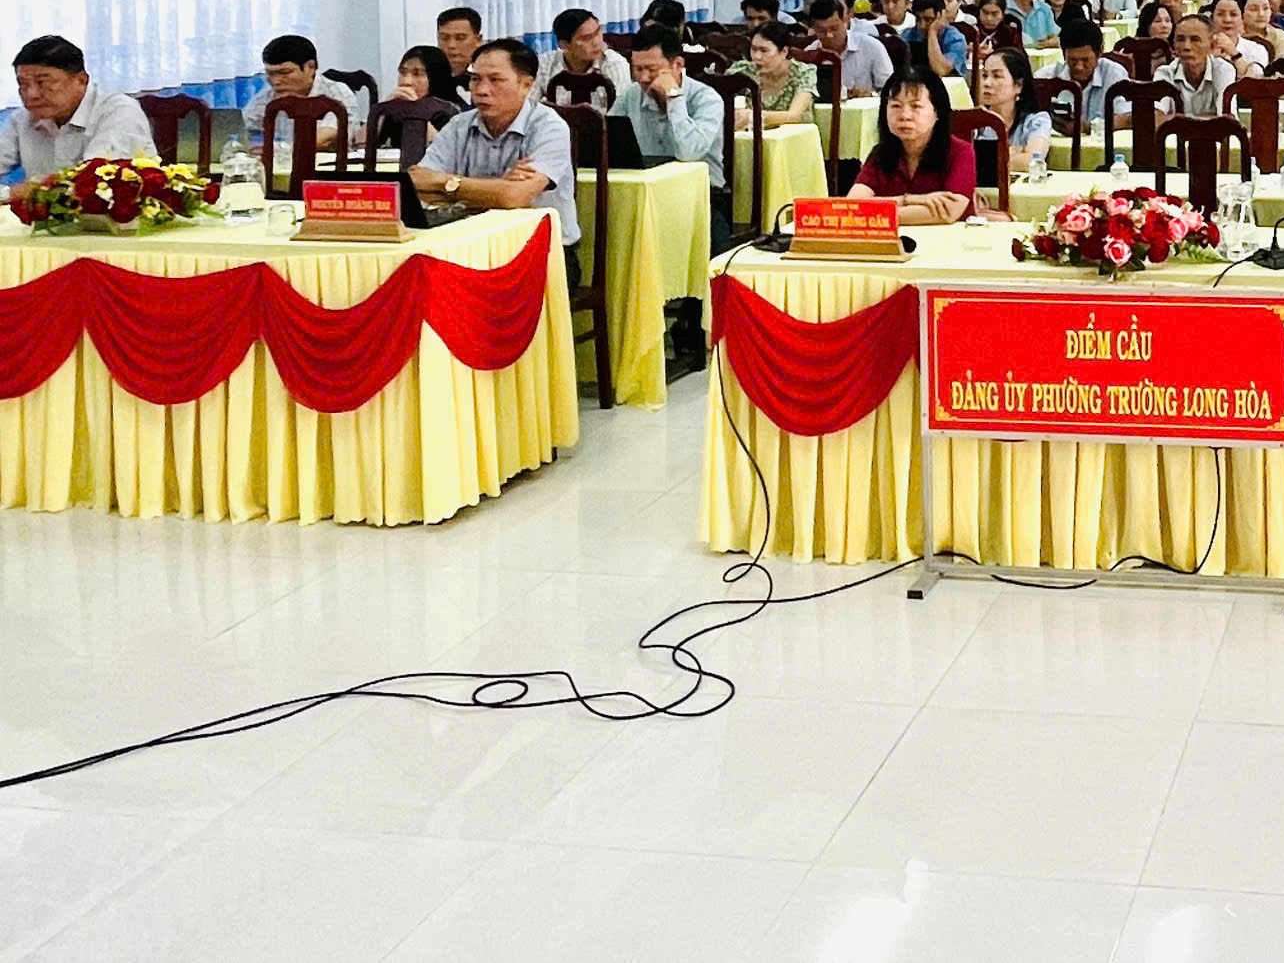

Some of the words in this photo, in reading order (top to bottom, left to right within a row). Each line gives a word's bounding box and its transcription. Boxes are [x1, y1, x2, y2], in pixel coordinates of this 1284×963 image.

[1065, 312, 1112, 360] ĐIỂM
[1116, 314, 1152, 362] CẦU
[952, 370, 999, 412] ĐẢNG
[1003, 370, 1029, 412] ỦY
[1031, 376, 1102, 414] PHƯỜNG
[1107, 378, 1178, 417] TRƯỜNG
[1182, 388, 1230, 418] LONG
[1233, 381, 1273, 420] HÒA
